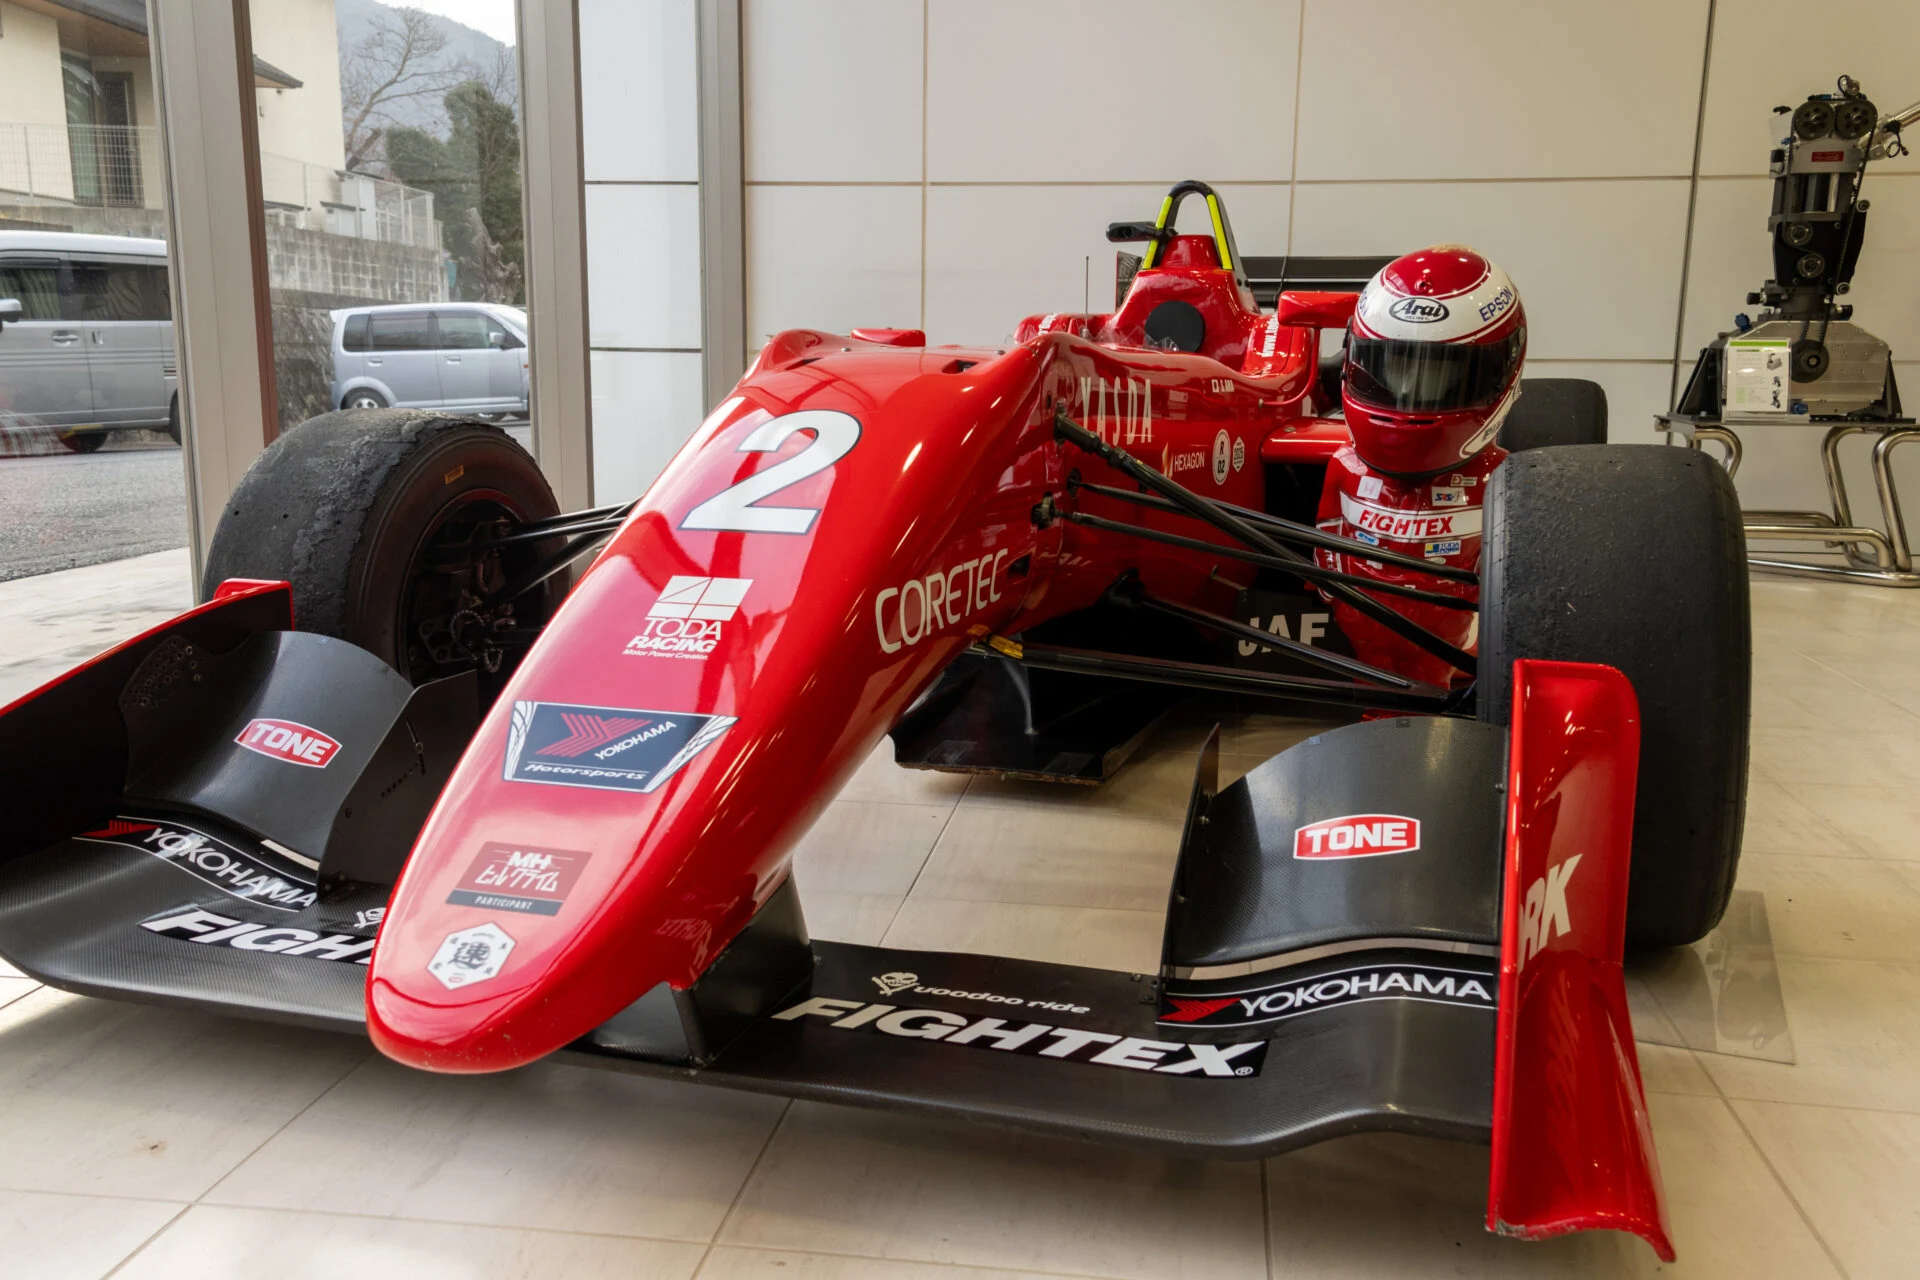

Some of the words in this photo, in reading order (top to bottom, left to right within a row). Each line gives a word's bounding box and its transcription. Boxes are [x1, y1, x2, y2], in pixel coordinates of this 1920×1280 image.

[1393, 299, 1443, 318] Arai
[1478, 284, 1513, 322] EPSON
[1080, 376, 1152, 446] YASDA
[677, 408, 863, 536] 2
[1174, 451, 1205, 472] HEXAGON
[1359, 509, 1453, 536] FIGHTEX
[875, 548, 1008, 654] CORETEC
[626, 635, 718, 653] RACING
[644, 617, 721, 641] TODA
[1238, 613, 1329, 656] JAF
[247, 723, 331, 763] TONE
[593, 720, 677, 760] YOKOHAMA
[524, 763, 646, 781] Motorsports
[1306, 822, 1407, 852] TONE
[143, 827, 318, 907] YOKOHAMA
[508, 851, 553, 870] MH
[474, 896, 534, 910] PARTICIPANT
[1518, 853, 1583, 976] RK
[140, 909, 375, 965] FIGH
[914, 986, 1024, 1005] voodoo
[1027, 1000, 1091, 1014] ride
[1239, 973, 1494, 1017] YOKOHAMA
